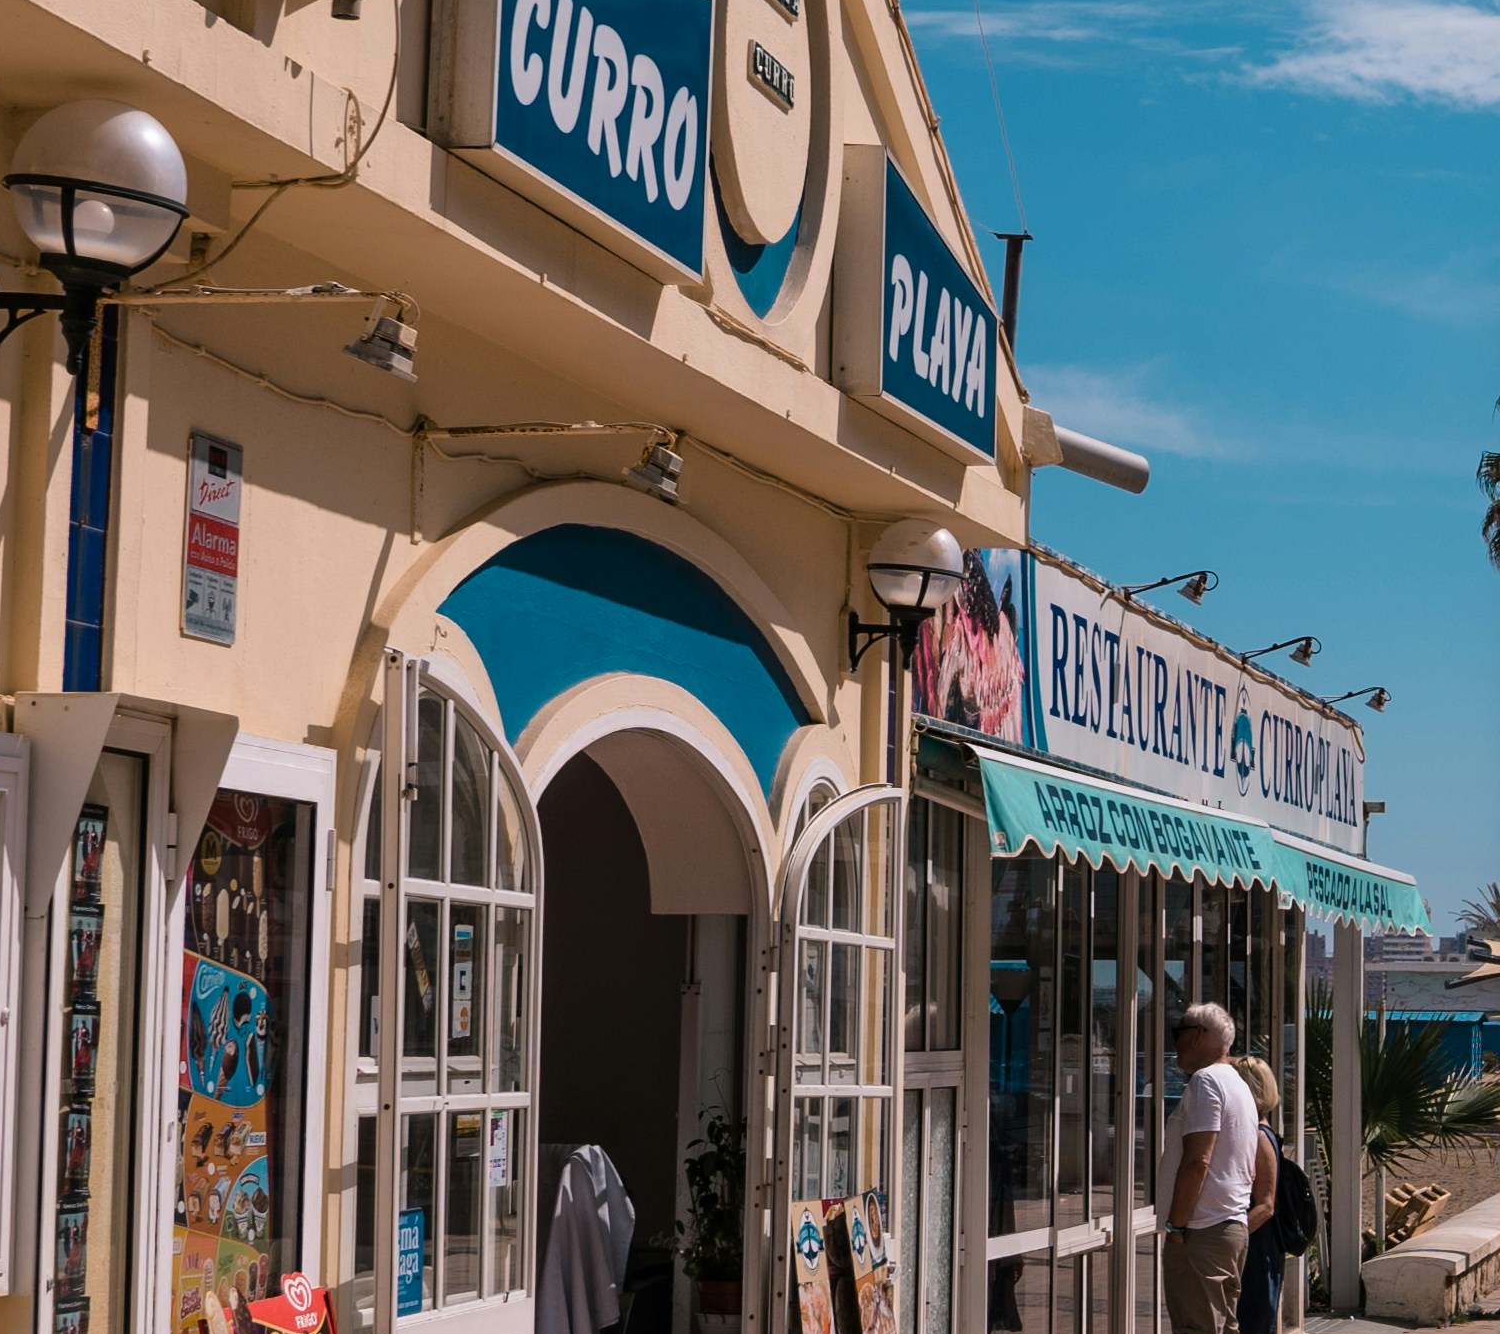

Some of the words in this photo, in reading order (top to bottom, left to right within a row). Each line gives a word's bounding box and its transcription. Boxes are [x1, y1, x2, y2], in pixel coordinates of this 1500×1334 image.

[755, 45, 795, 104] CURRO
[888, 252, 987, 419] PLAYA
[198, 478, 235, 506] Direct
[191, 522, 237, 556] Alarma
[1050, 602, 1227, 779] RESTAURANTE
[1260, 709, 1315, 814] CURRO
[1318, 736, 1358, 828] PLAYA
[1034, 780, 1113, 845] ARROZ
[1106, 799, 1155, 854] CON
[1147, 809, 1262, 871] BOGAVANTE
[1306, 861, 1350, 912] PESCADO
[1351, 878, 1358, 912] A
[1359, 879, 1373, 915] LA
[1373, 882, 1393, 918] SAL
[399, 1252, 419, 1285] aga
[295, 1312, 318, 1330] FRIGO
